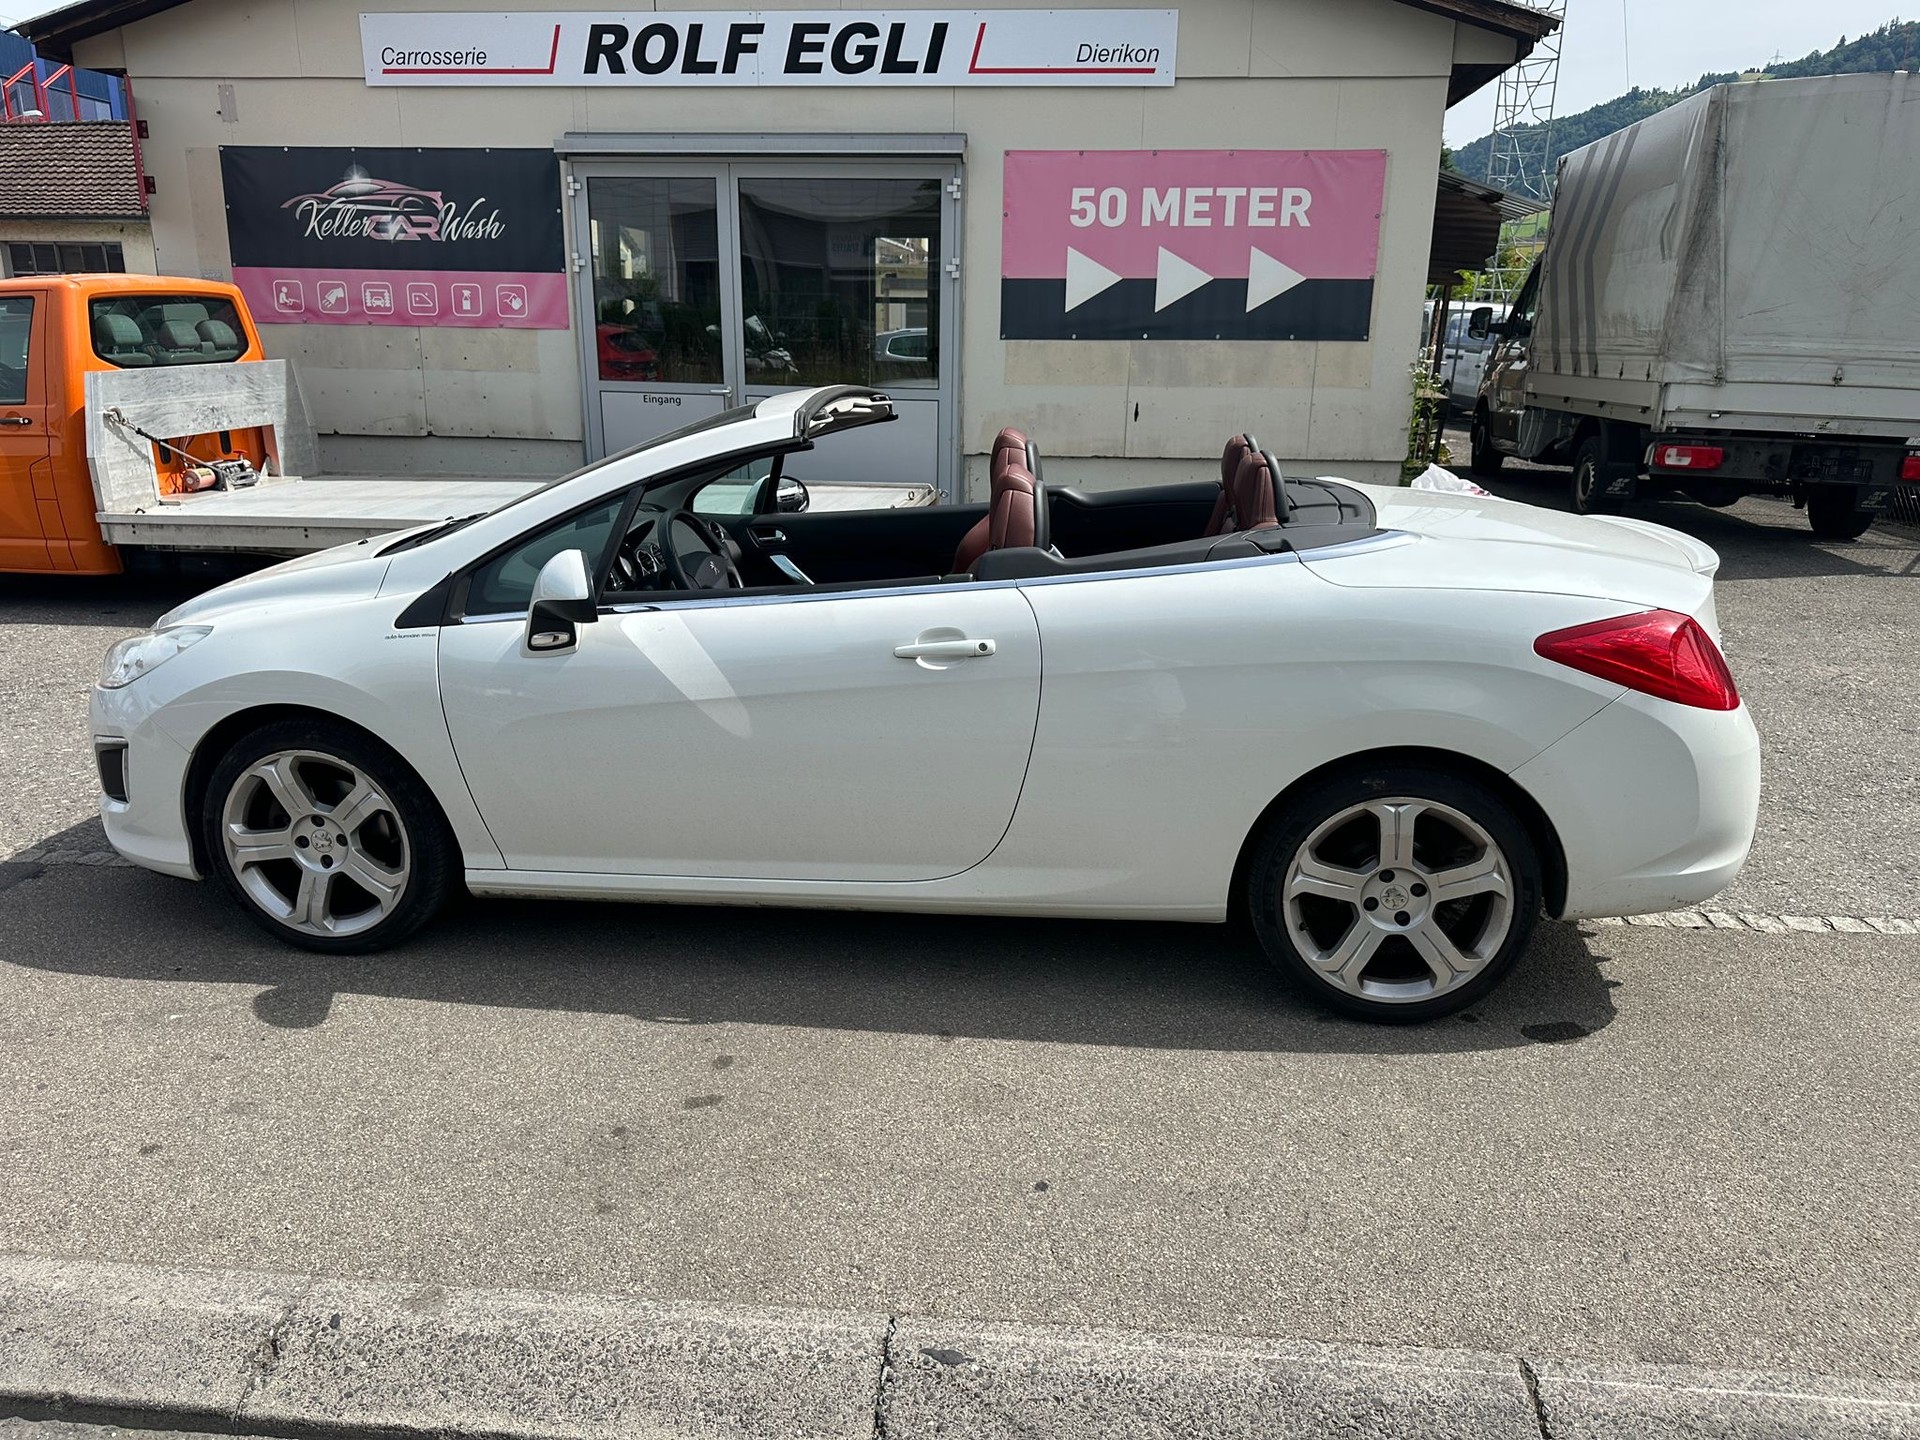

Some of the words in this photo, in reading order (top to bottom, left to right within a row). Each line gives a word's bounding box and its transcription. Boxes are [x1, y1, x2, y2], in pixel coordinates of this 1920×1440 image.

[381, 46, 487, 66] Carrosserie
[583, 22, 766, 75] ROLF
[783, 22, 949, 75] EGLI
[1076, 43, 1160, 63] Dierikon
[295, 197, 377, 241] Keller
[368, 214, 442, 241] CAR
[438, 197, 506, 242] Wash
[1069, 186, 1128, 228] 50
[1140, 186, 1313, 228] METER
[643, 394, 682, 407] Eingang
